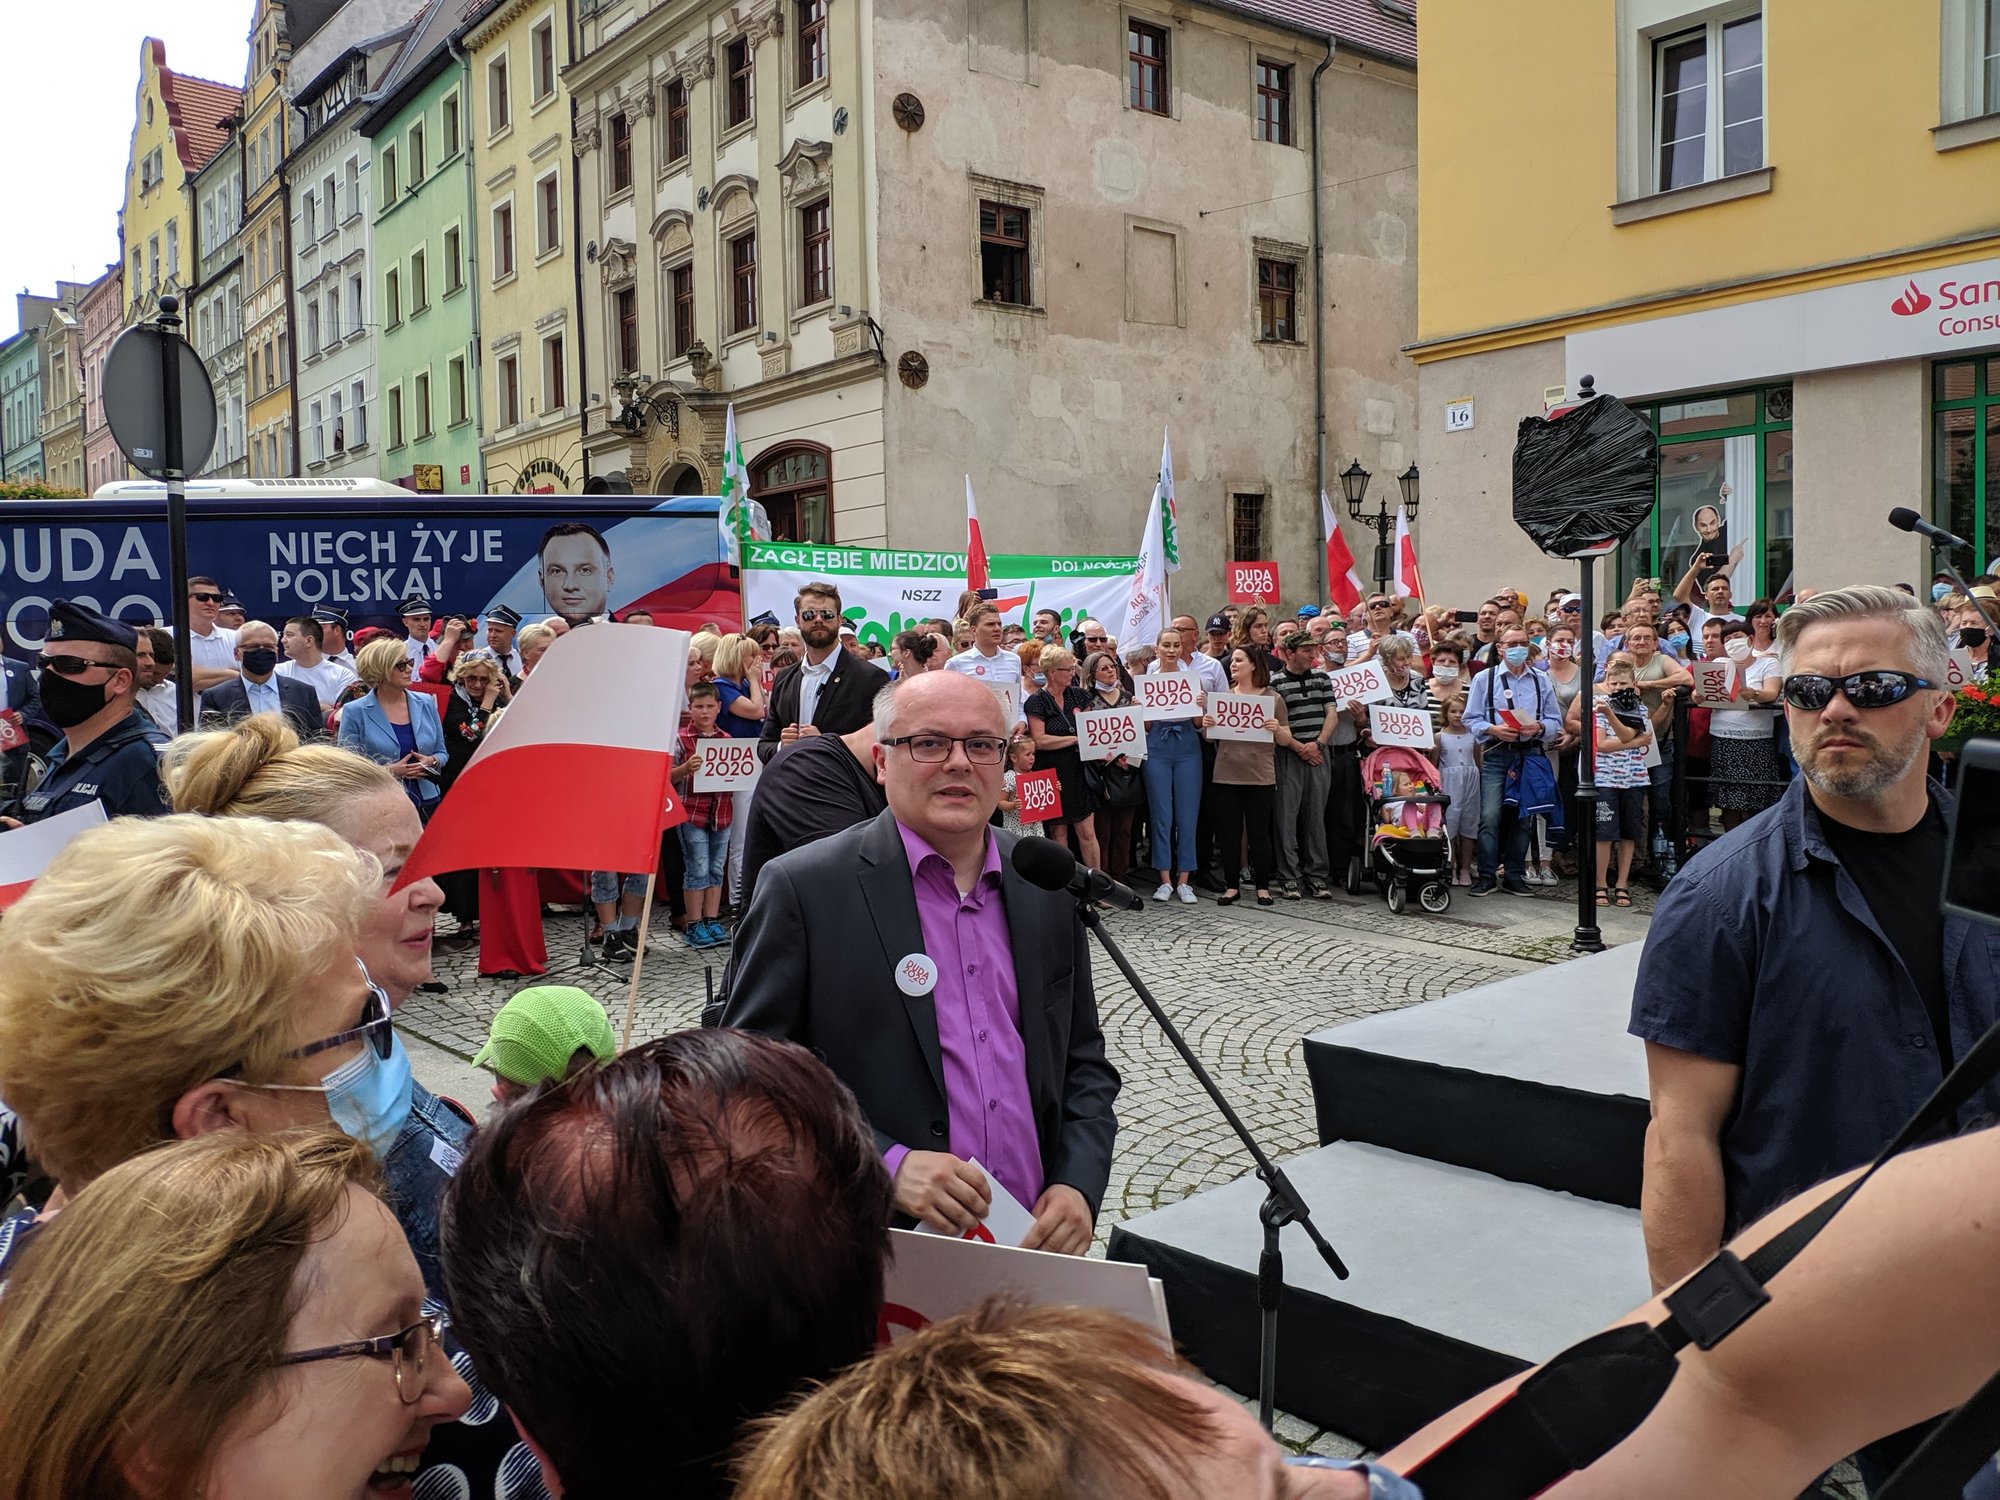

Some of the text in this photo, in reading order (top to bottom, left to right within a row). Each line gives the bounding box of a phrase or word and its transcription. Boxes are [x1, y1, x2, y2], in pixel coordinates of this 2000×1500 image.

[1939, 281, 2000, 310] San
[1450, 409, 1469, 424] 16
[269, 521, 504, 566] NIECH ŻYJE
[0, 526, 161, 583] UDA
[750, 546, 863, 573] ZAGŁĘBIE
[1235, 569, 1272, 581] DUDA
[271, 566, 443, 603] POLSKA!
[1235, 580, 1273, 593] 2020
[901, 589, 942, 602] NSZZ
[1144, 679, 1191, 695] DUDA
[1330, 669, 1376, 689] DUDA
[1702, 670, 1720, 703] DUDA
[1333, 678, 1379, 700] 2020
[1146, 691, 1193, 708] 2020
[1217, 700, 1264, 717] DUDA
[1086, 715, 1134, 733] DUDA
[1216, 713, 1265, 729] 2020
[1378, 711, 1423, 727] DUDA
[1088, 728, 1136, 746] 2020
[1381, 722, 1425, 737] 2020
[705, 746, 754, 762] DUDA
[704, 761, 754, 777] 2020
[1023, 778, 1054, 796] DUDA
[1025, 790, 1055, 810] 2020
[902, 966, 927, 985] 2020
[906, 959, 929, 981] DUDA
